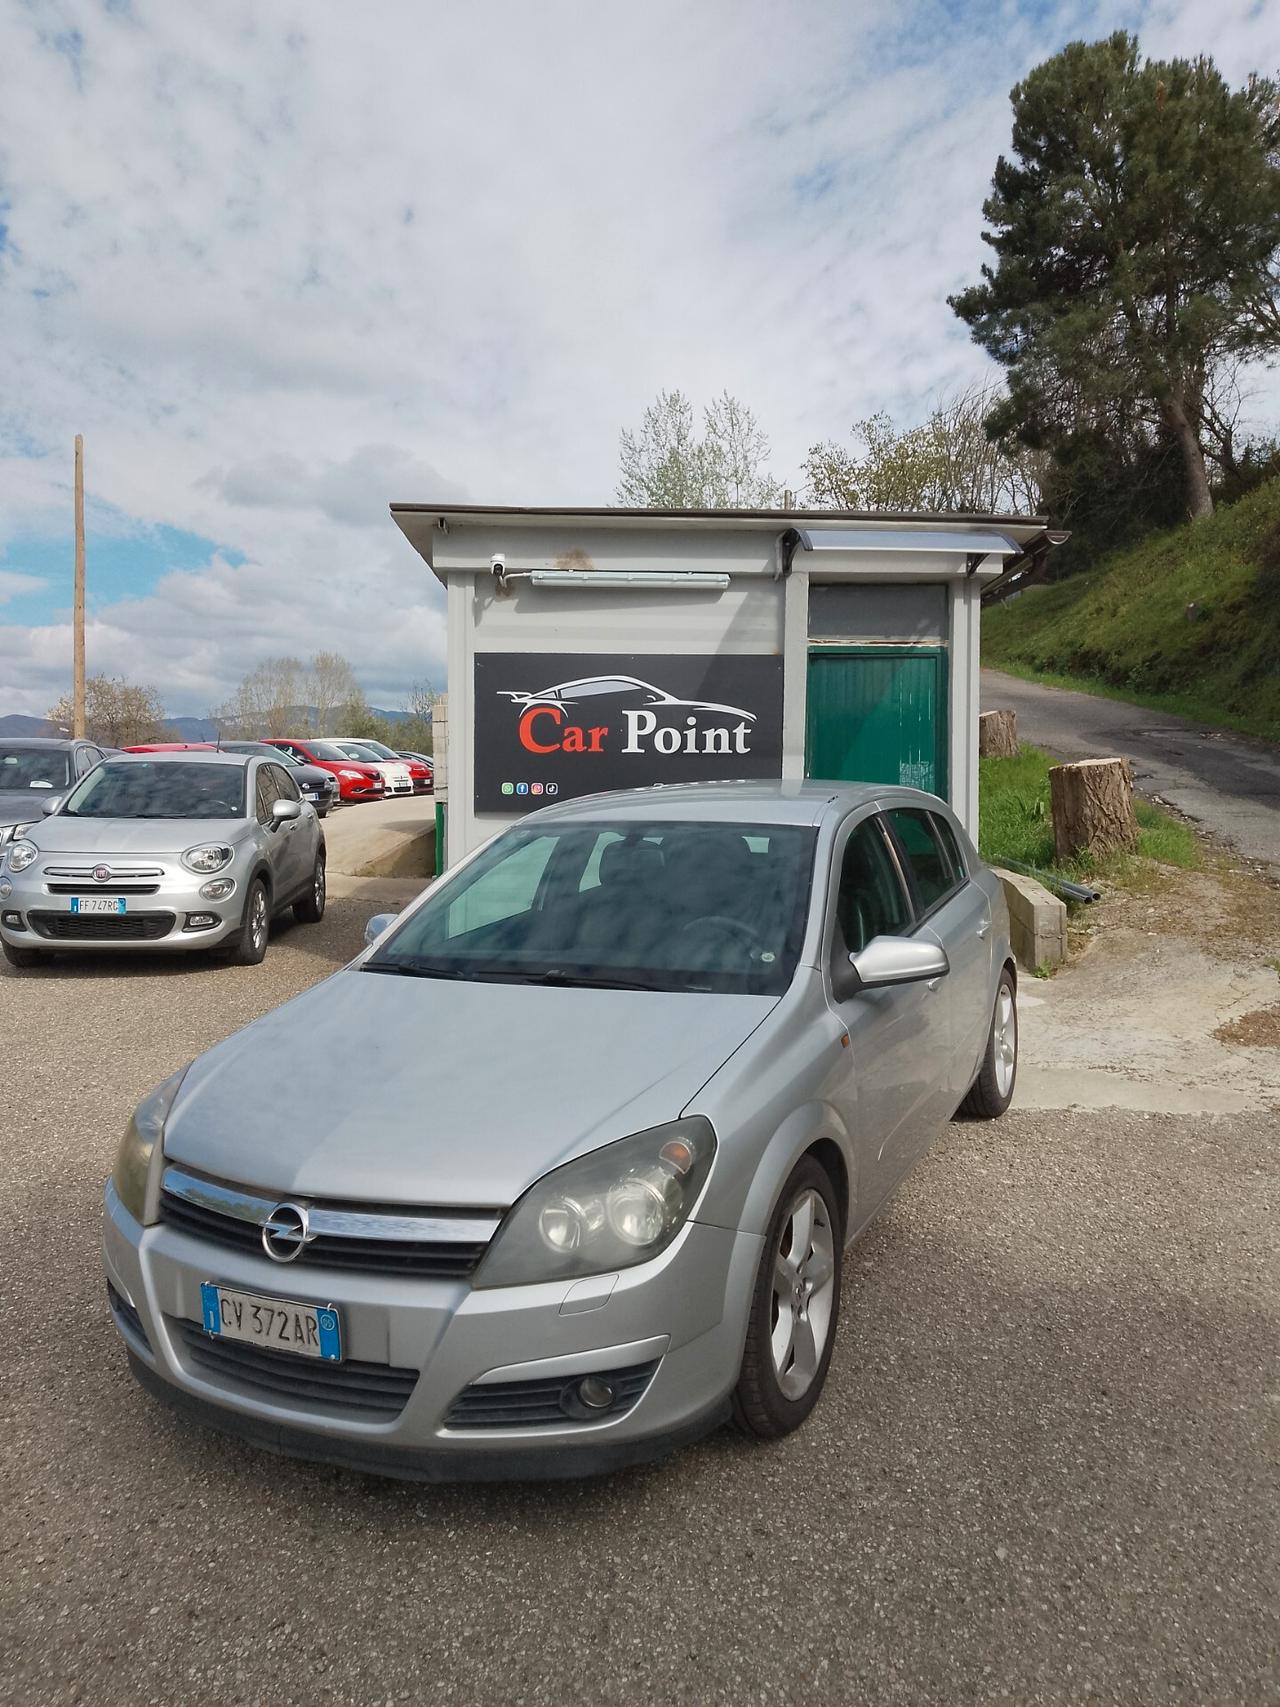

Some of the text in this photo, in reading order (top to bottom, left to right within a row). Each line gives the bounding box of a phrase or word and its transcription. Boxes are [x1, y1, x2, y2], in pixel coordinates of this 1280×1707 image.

[519, 707, 752, 754] Car Point
[79, 900, 89, 911] FF
[220, 1298, 319, 1346] CV 372AR
